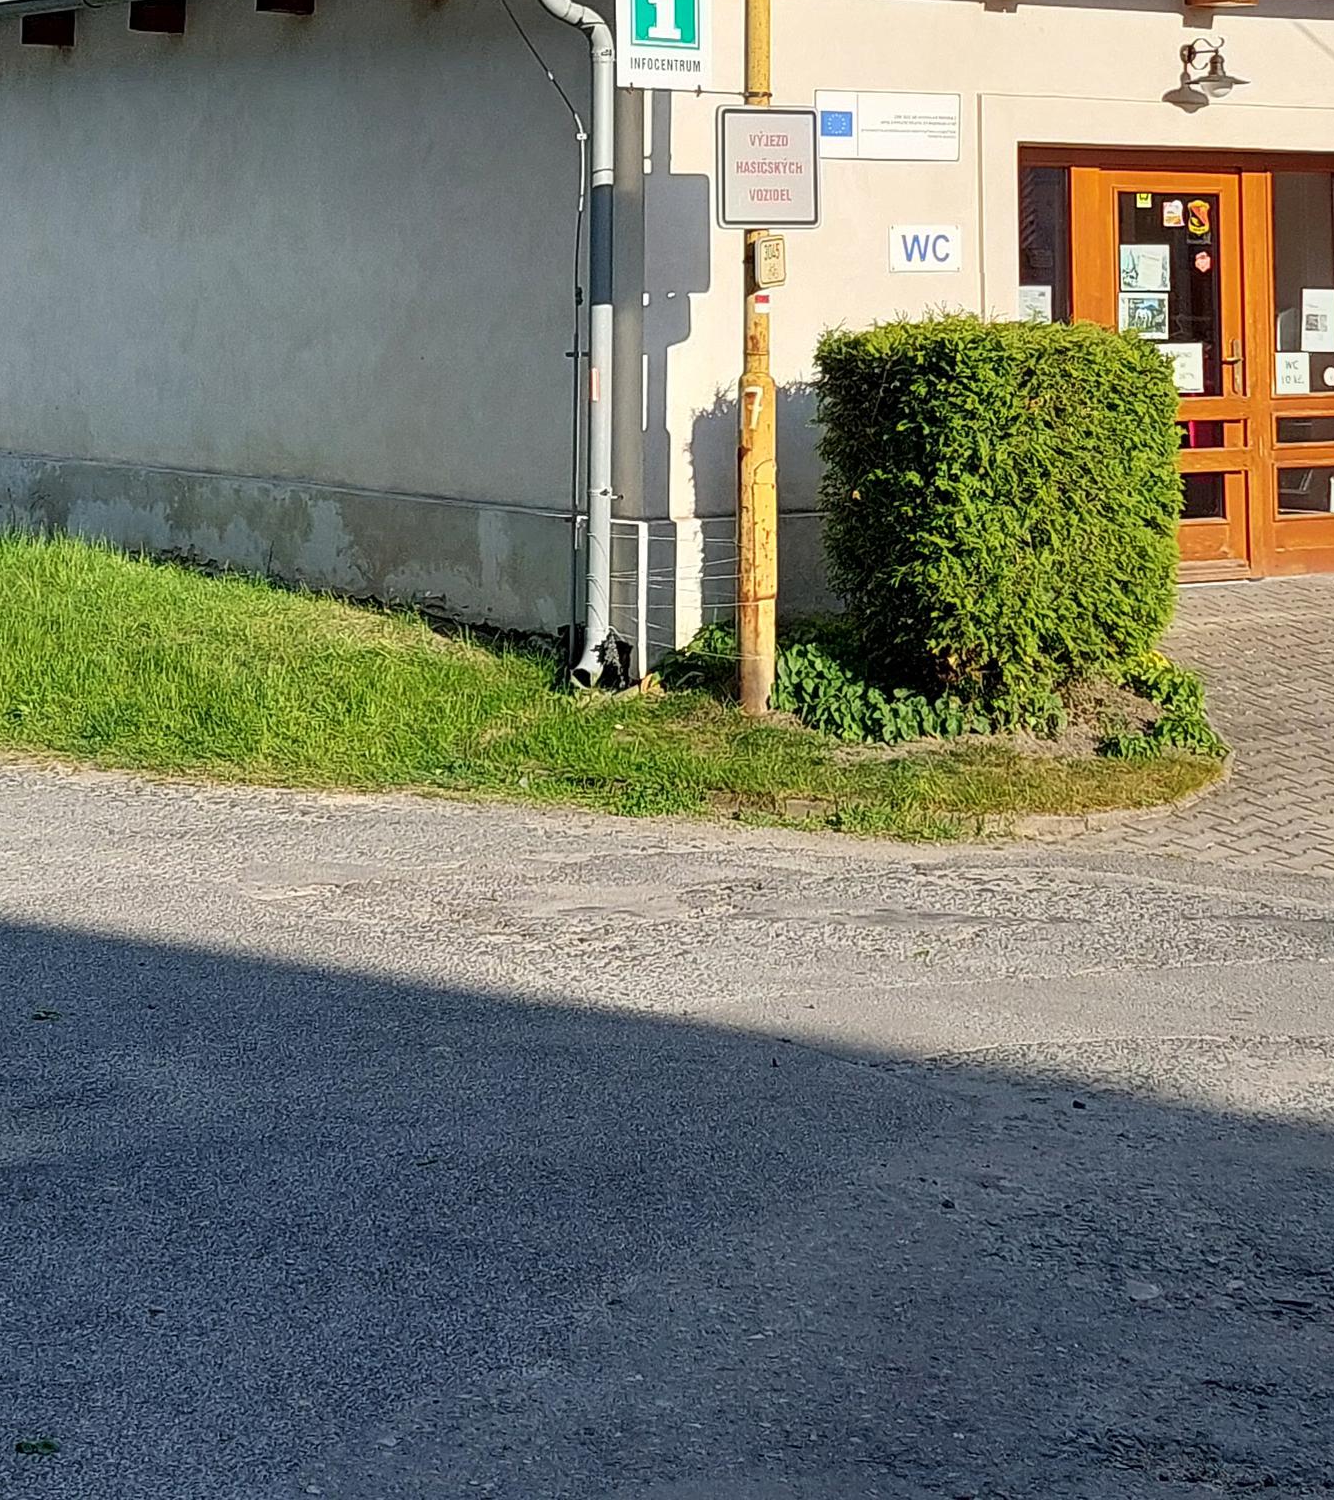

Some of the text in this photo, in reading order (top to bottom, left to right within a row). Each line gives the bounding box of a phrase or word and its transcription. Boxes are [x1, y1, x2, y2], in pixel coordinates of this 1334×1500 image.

[630, 56, 701, 73] INFOCENTRUM
[749, 131, 789, 147] VÝJEZD
[736, 158, 803, 174] HASIČSKÝCH
[749, 188, 792, 202] VOZIDEL
[900, 234, 950, 263] WC
